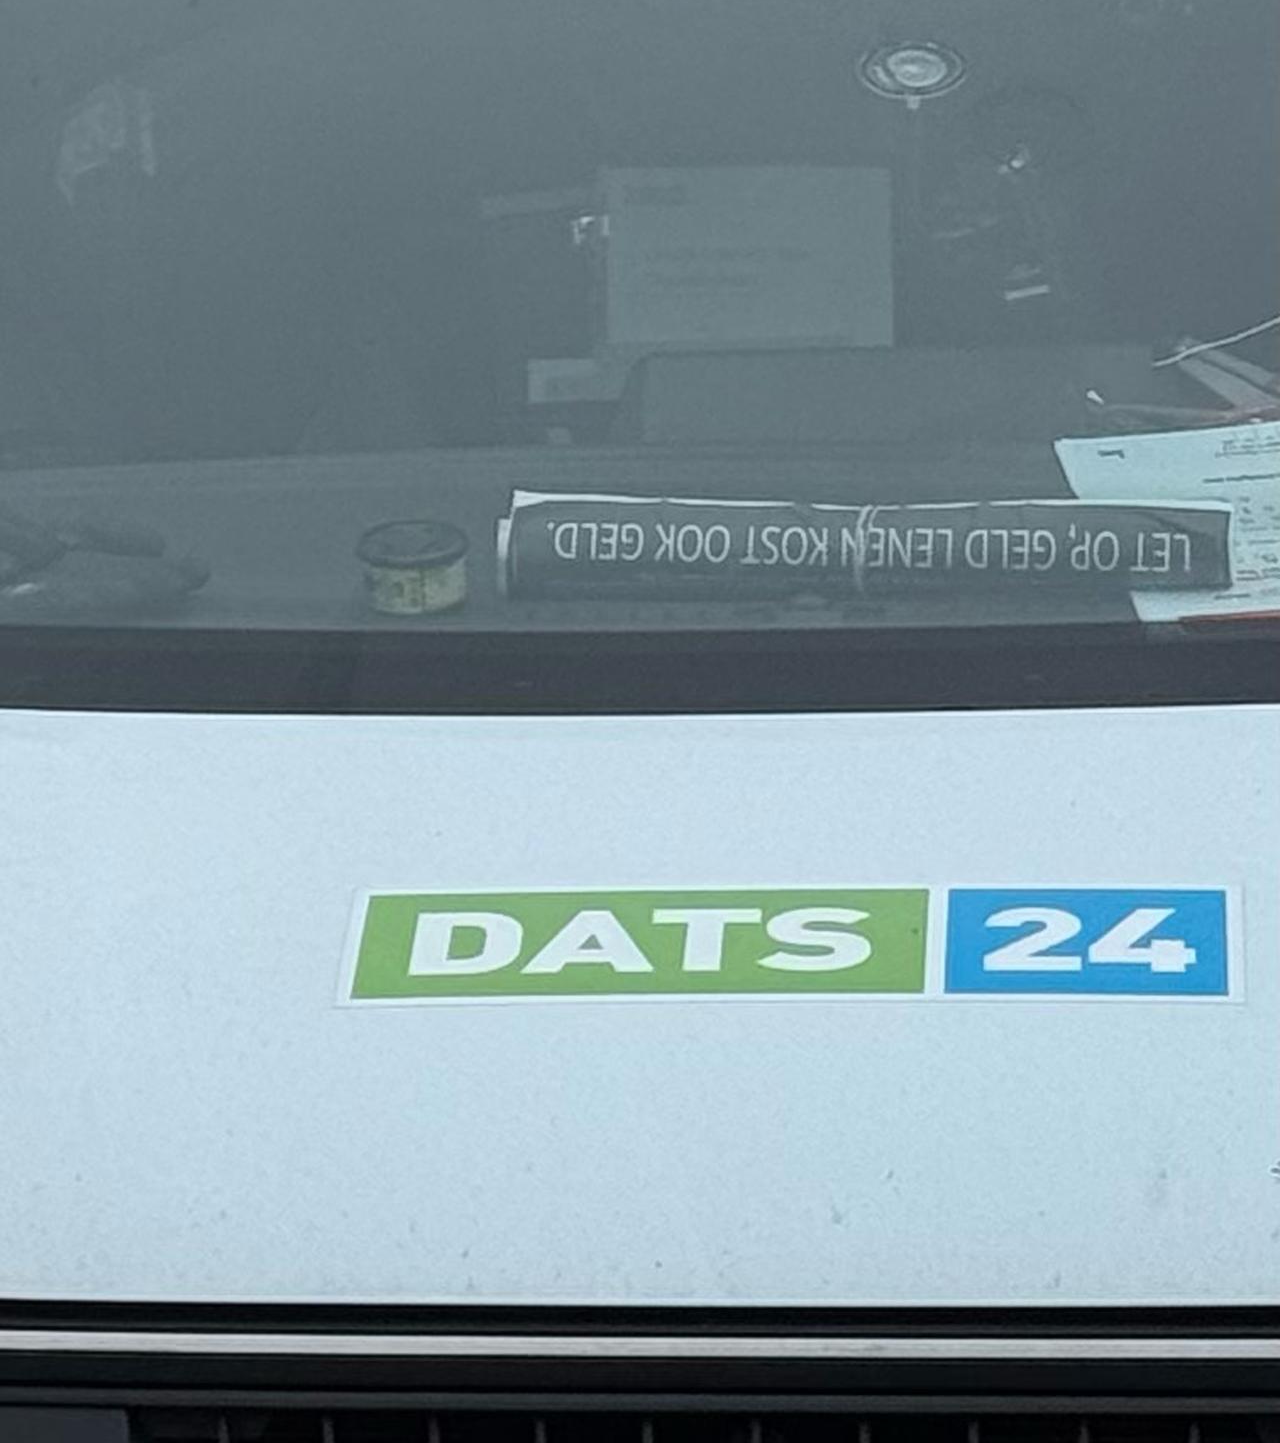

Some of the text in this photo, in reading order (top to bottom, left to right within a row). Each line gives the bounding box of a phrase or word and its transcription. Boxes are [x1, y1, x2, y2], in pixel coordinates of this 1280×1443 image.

[547, 521, 645, 562] GELD.
[654, 522, 731, 563] OOK
[739, 524, 829, 567] KOST
[840, 525, 953, 569] LENEN
[964, 528, 1058, 571] GELD
[1069, 522, 1121, 572] OP,
[1130, 531, 1191, 573] LET
[407, 906, 1197, 976] DATS 24
